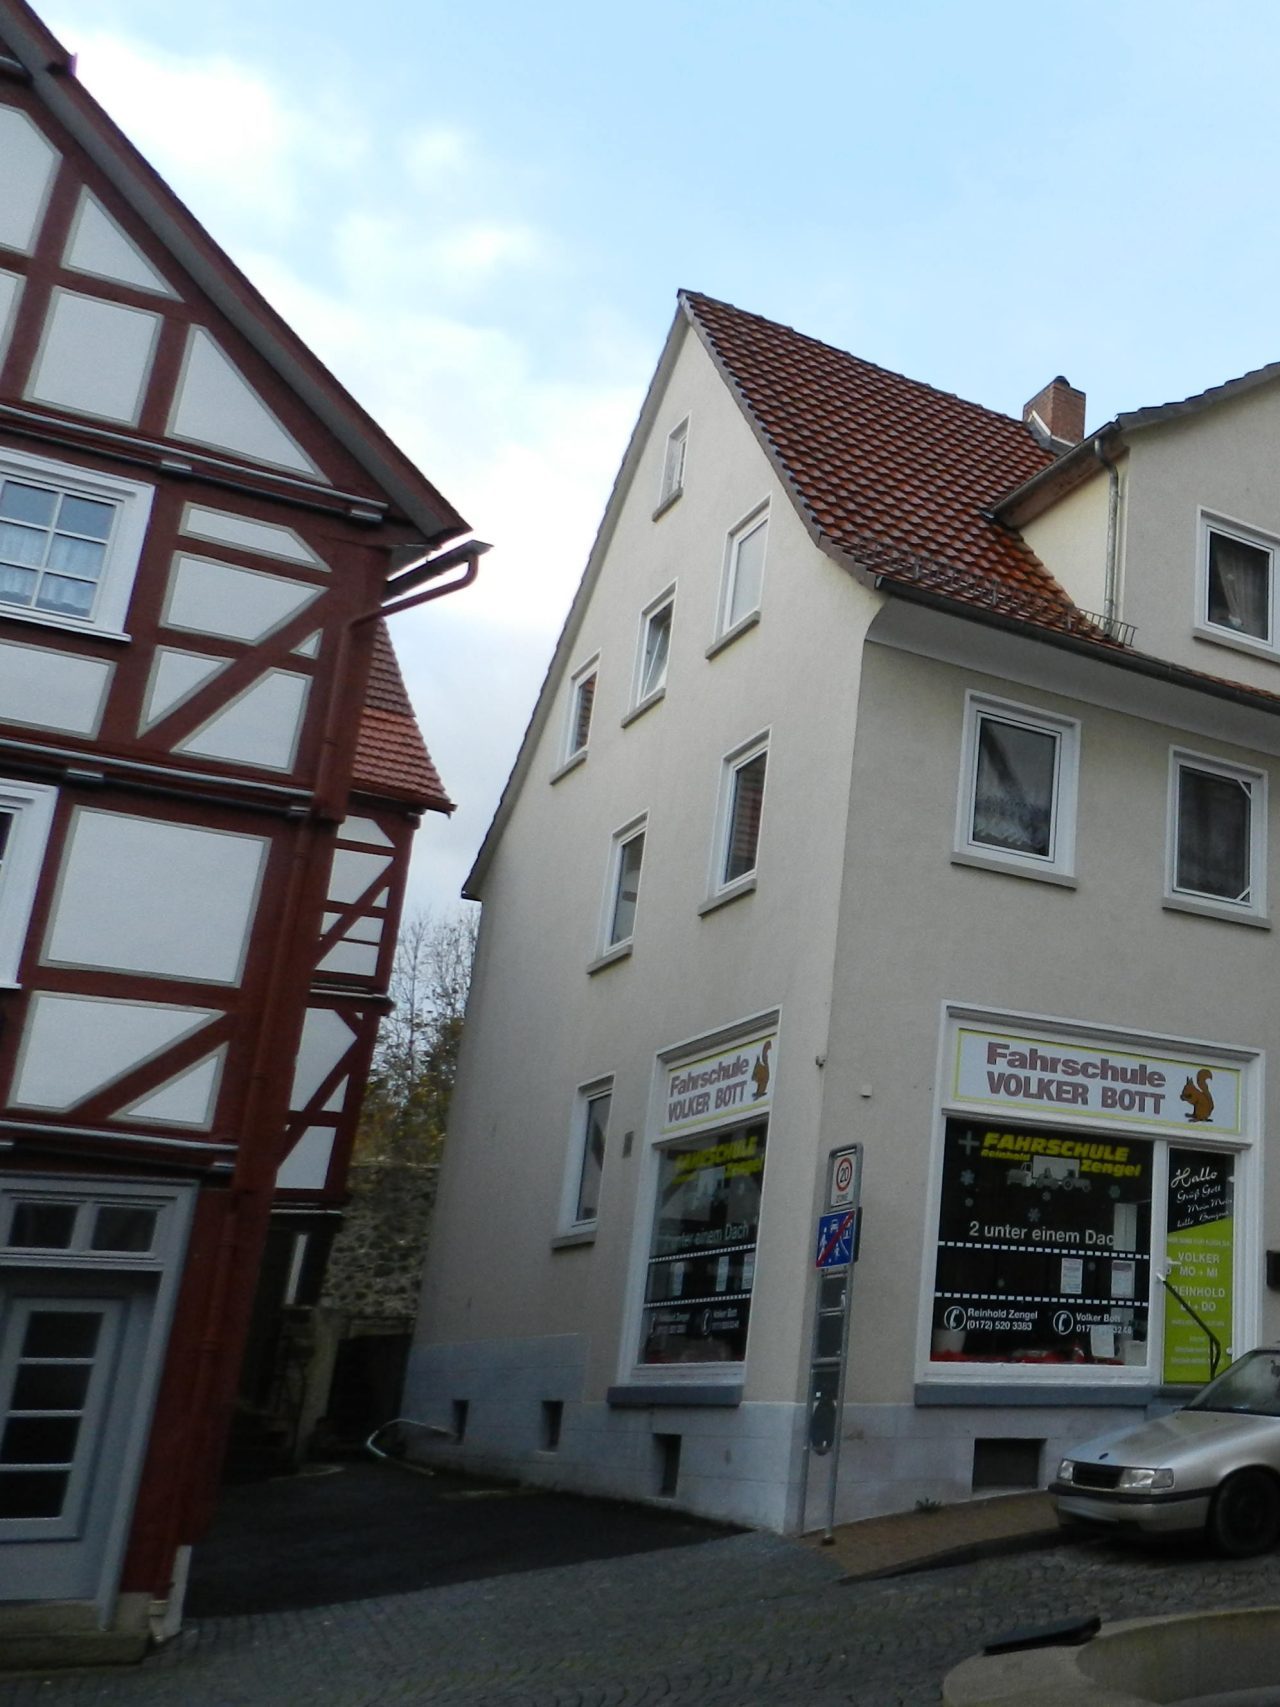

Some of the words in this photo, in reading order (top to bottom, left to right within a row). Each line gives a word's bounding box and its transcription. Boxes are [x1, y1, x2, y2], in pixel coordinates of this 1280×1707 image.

[987, 1041, 1166, 1088] Fahrschule
[670, 1055, 749, 1098] Fahrschule
[668, 1092, 711, 1122] VOLKER
[715, 1080, 748, 1109] BOTT
[987, 1071, 1089, 1106] VOLKER
[1101, 1085, 1166, 1115] BOTT
[982, 1132, 1131, 1162] FAHRSCHULE
[840, 1166, 850, 1183] 20
[1080, 1159, 1142, 1177] Zengel
[1170, 1166, 1218, 1188] Hallo
[969, 1221, 980, 1237] 2
[984, 1225, 1027, 1239] unter
[1032, 1226, 1080, 1243] einem
[1085, 1230, 1115, 1246] Dac
[1178, 1252, 1220, 1264] VOLKER
[966, 1319, 993, 1331] (0172)
[995, 1321, 1010, 1330] 520
[967, 1307, 1006, 1319] Reinhold
[1008, 1309, 1038, 1321] Zengel
[1076, 1312, 1101, 1322] Volker
